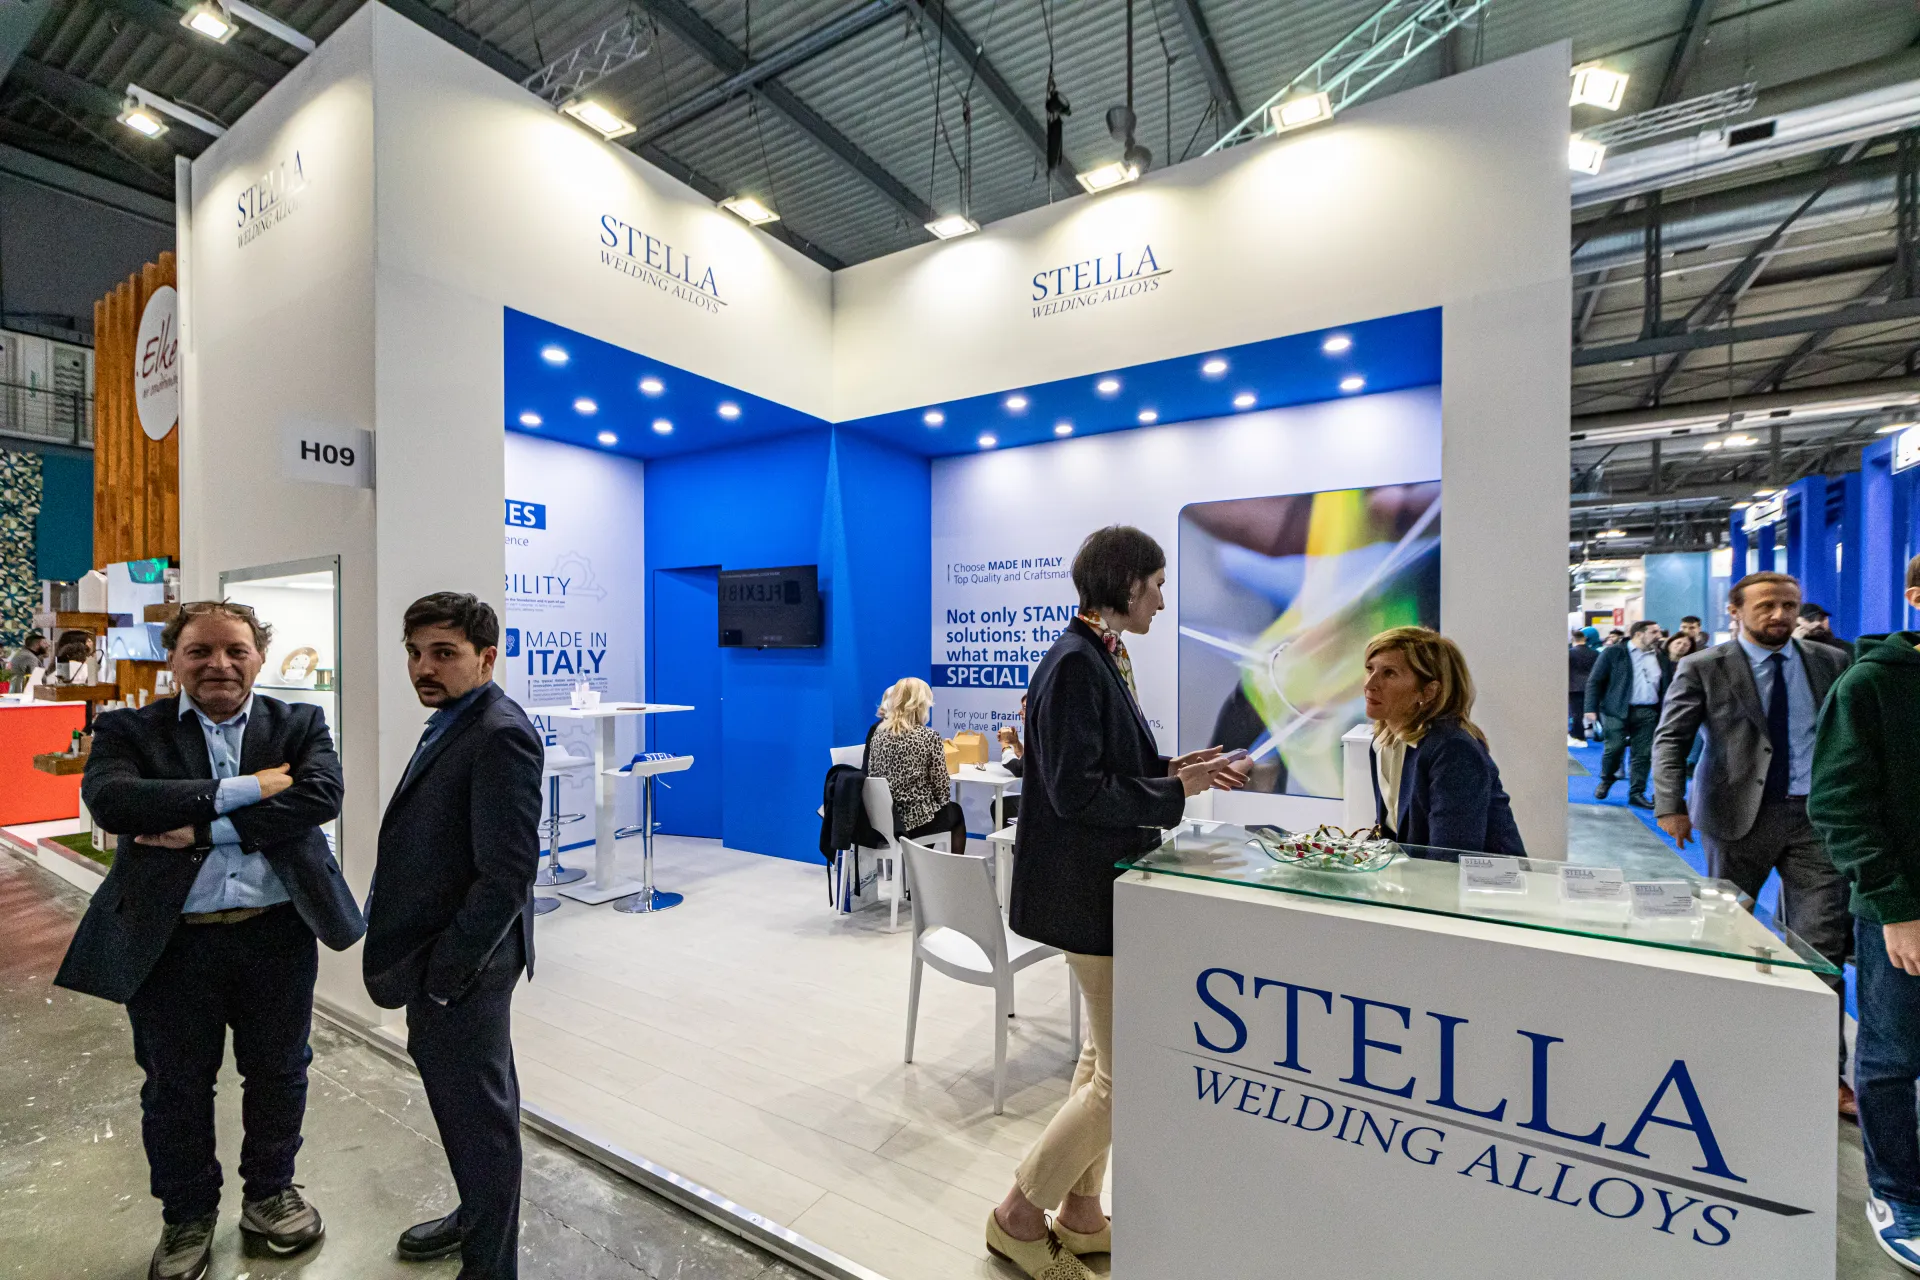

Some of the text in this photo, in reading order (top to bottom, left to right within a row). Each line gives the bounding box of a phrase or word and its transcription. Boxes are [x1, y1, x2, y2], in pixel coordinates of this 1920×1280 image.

[600, 213, 720, 298] STELLA
[600, 250, 720, 315] WELDING ALLOYS
[1032, 244, 1162, 302] STELLA
[1032, 276, 1161, 319] WELDING ALLOYS
[300, 439, 355, 467] H09
[505, 500, 536, 526] ES
[953, 563, 986, 573] Choose
[988, 559, 1018, 571] MADE
[1021, 558, 1032, 569] IN
[954, 574, 969, 585] Top
[971, 572, 1002, 585] Quality
[1004, 571, 1021, 582] and
[946, 609, 975, 624] Not
[981, 606, 1017, 627] only
[526, 631, 607, 648] MADE IN
[946, 625, 1067, 643] solutions: tha
[527, 649, 606, 676] ITALY
[946, 646, 988, 662] what
[946, 666, 1025, 686] SPECIAL
[953, 709, 967, 719] For
[968, 711, 988, 721] your
[953, 722, 966, 730] we
[968, 720, 989, 731] have
[644, 752, 674, 761] STEL
[1564, 869, 1594, 877] STELLA
[1193, 967, 1748, 1184] STELLA
[1192, 1065, 1740, 1248] WELDING ALLOYS
